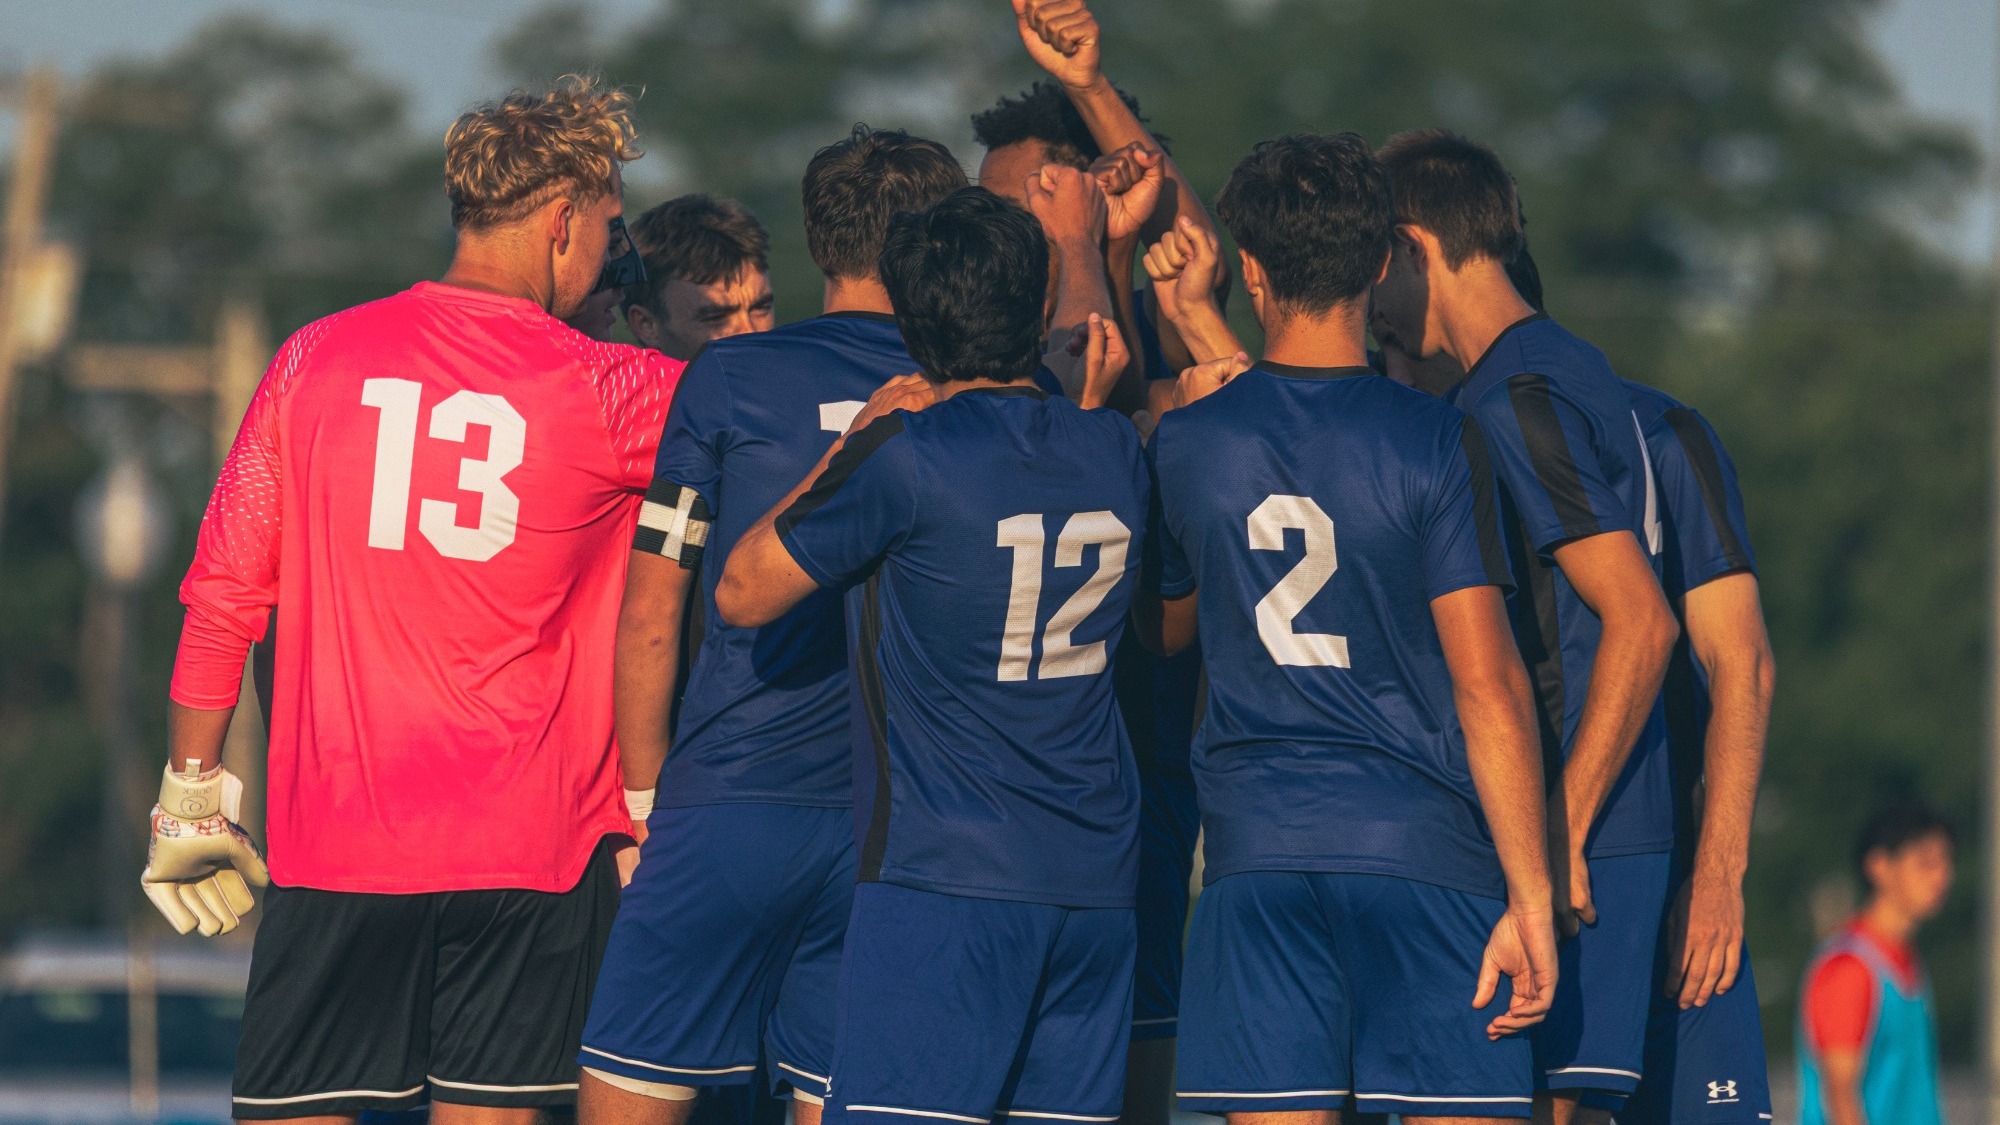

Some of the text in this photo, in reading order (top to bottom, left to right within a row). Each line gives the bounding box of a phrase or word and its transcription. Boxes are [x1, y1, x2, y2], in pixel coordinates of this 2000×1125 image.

[360, 377, 527, 562] 13
[996, 510, 1132, 682] 12
[1246, 493, 1351, 669] 2
[183, 786, 212, 795] QUICK
